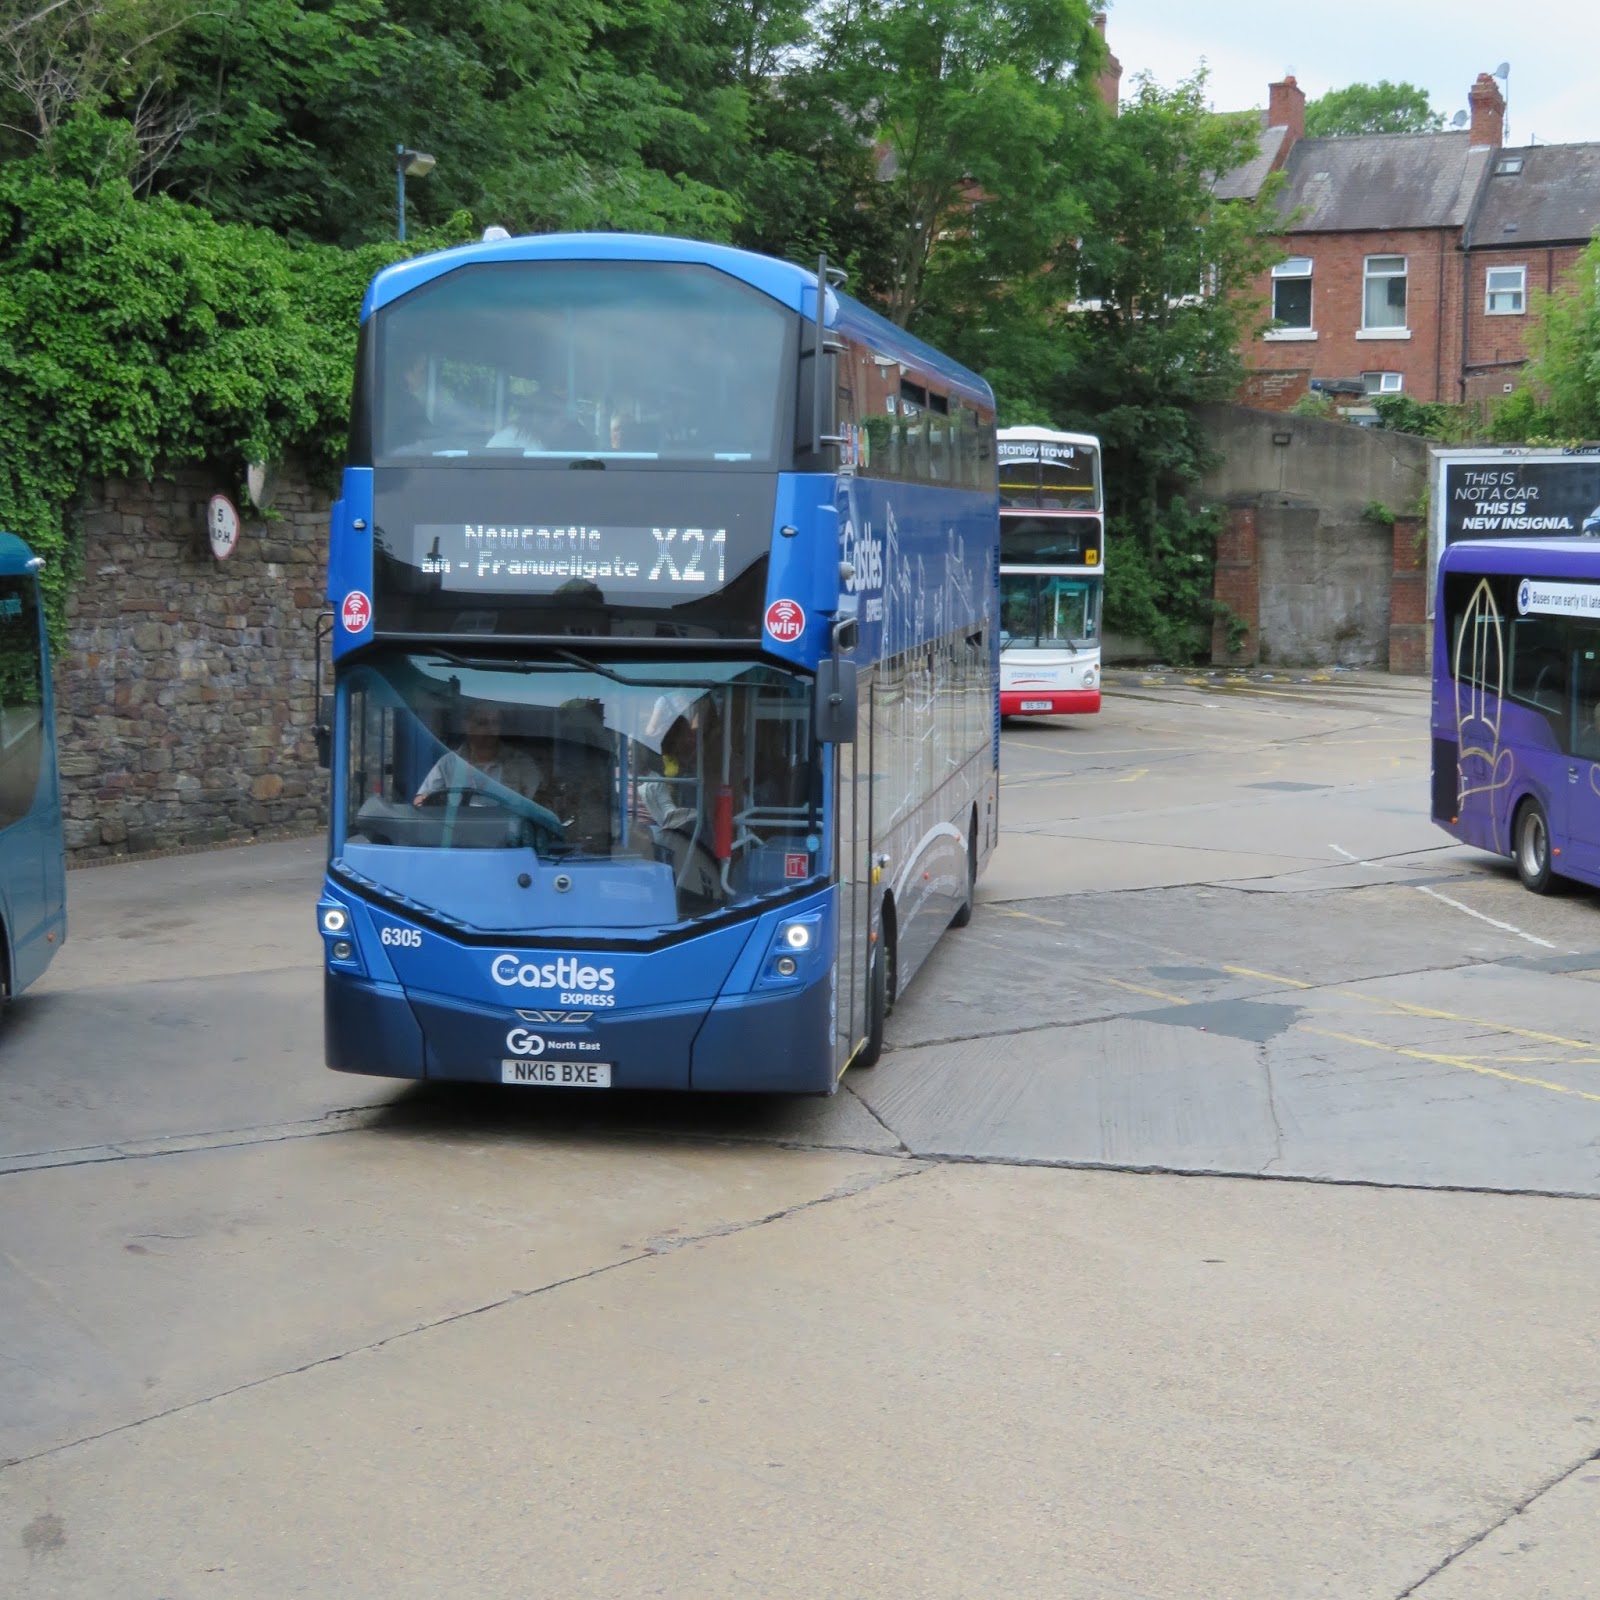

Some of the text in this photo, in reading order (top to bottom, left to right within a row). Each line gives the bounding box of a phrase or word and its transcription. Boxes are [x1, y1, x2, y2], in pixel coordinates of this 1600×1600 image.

[998, 443, 1074, 458] stanley travel
[1464, 472, 1514, 485] THIS IS
[1455, 487, 1540, 500] NOT A CAR.
[217, 508, 224, 523] 5
[1475, 502, 1526, 515] THIS IS
[1462, 517, 1574, 531] NEW INSIGNIA.
[464, 524, 601, 550] Newcastle
[648, 528, 727, 582] X21
[843, 520, 883, 593] Castles
[477, 550, 641, 579] Framwellgate
[381, 927, 422, 947] 6305
[491, 954, 616, 991] Castles
[560, 993, 615, 1006] EXPRESS
[547, 1041, 577, 1050] North
[578, 1042, 601, 1050] East
[515, 1062, 598, 1083] NK16 BXE
